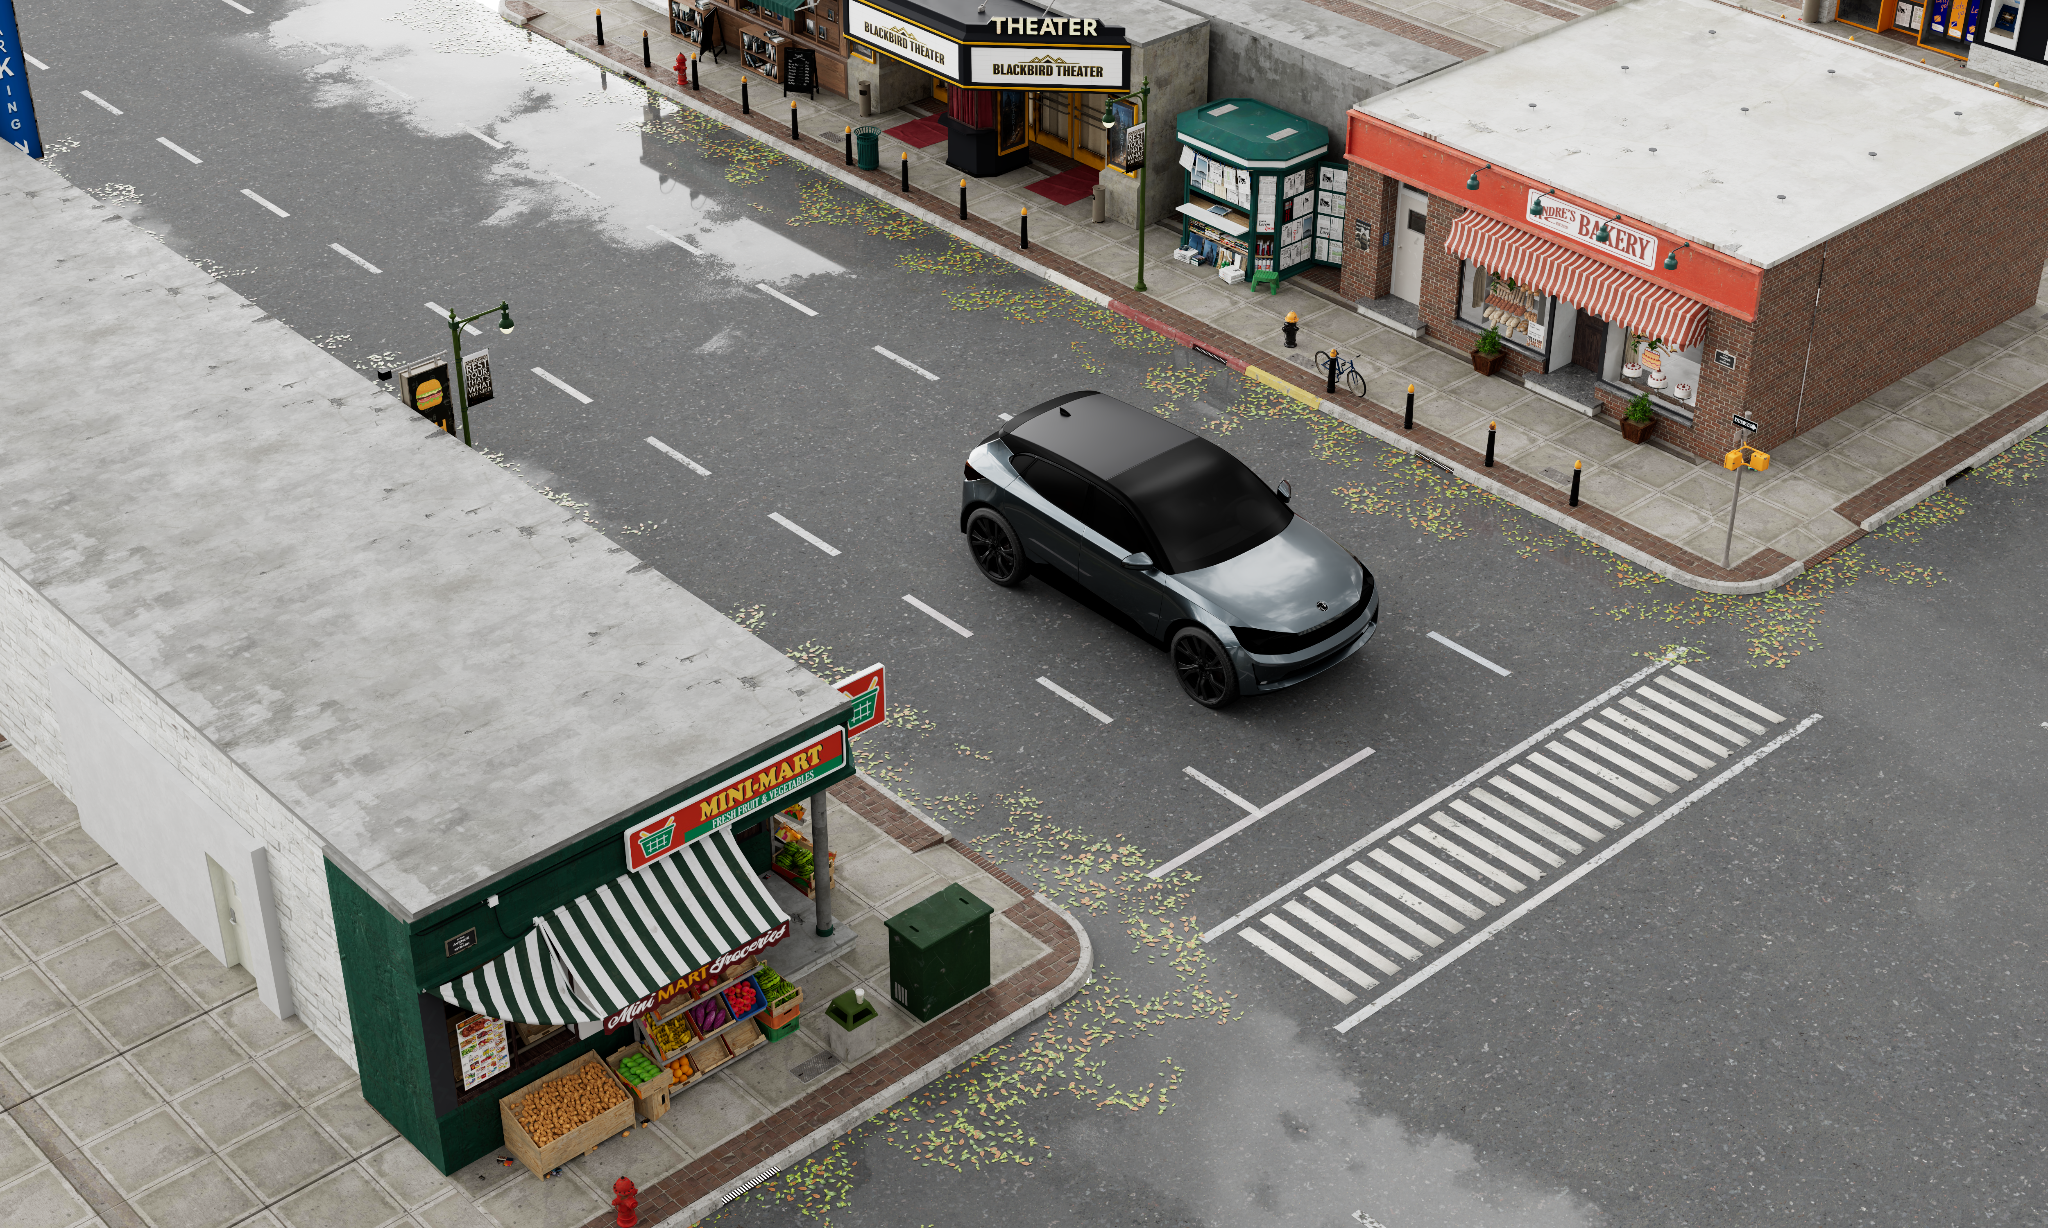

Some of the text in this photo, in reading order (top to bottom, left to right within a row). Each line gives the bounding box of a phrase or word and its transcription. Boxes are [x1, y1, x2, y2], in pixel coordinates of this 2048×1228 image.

[991, 16, 1098, 36] THEATER
[864, 20, 945, 66] BLACKBIRD THEATER
[992, 63, 1104, 78] BLACKBIRD THEATER
[466, 359, 487, 375] REST
[468, 380, 490, 394] WHAT
[699, 744, 824, 822] MINI-MART
[711, 770, 815, 829] FRESH FRUIT & VEGETABLES
[607, 924, 787, 1030] Mini MART Groceries
